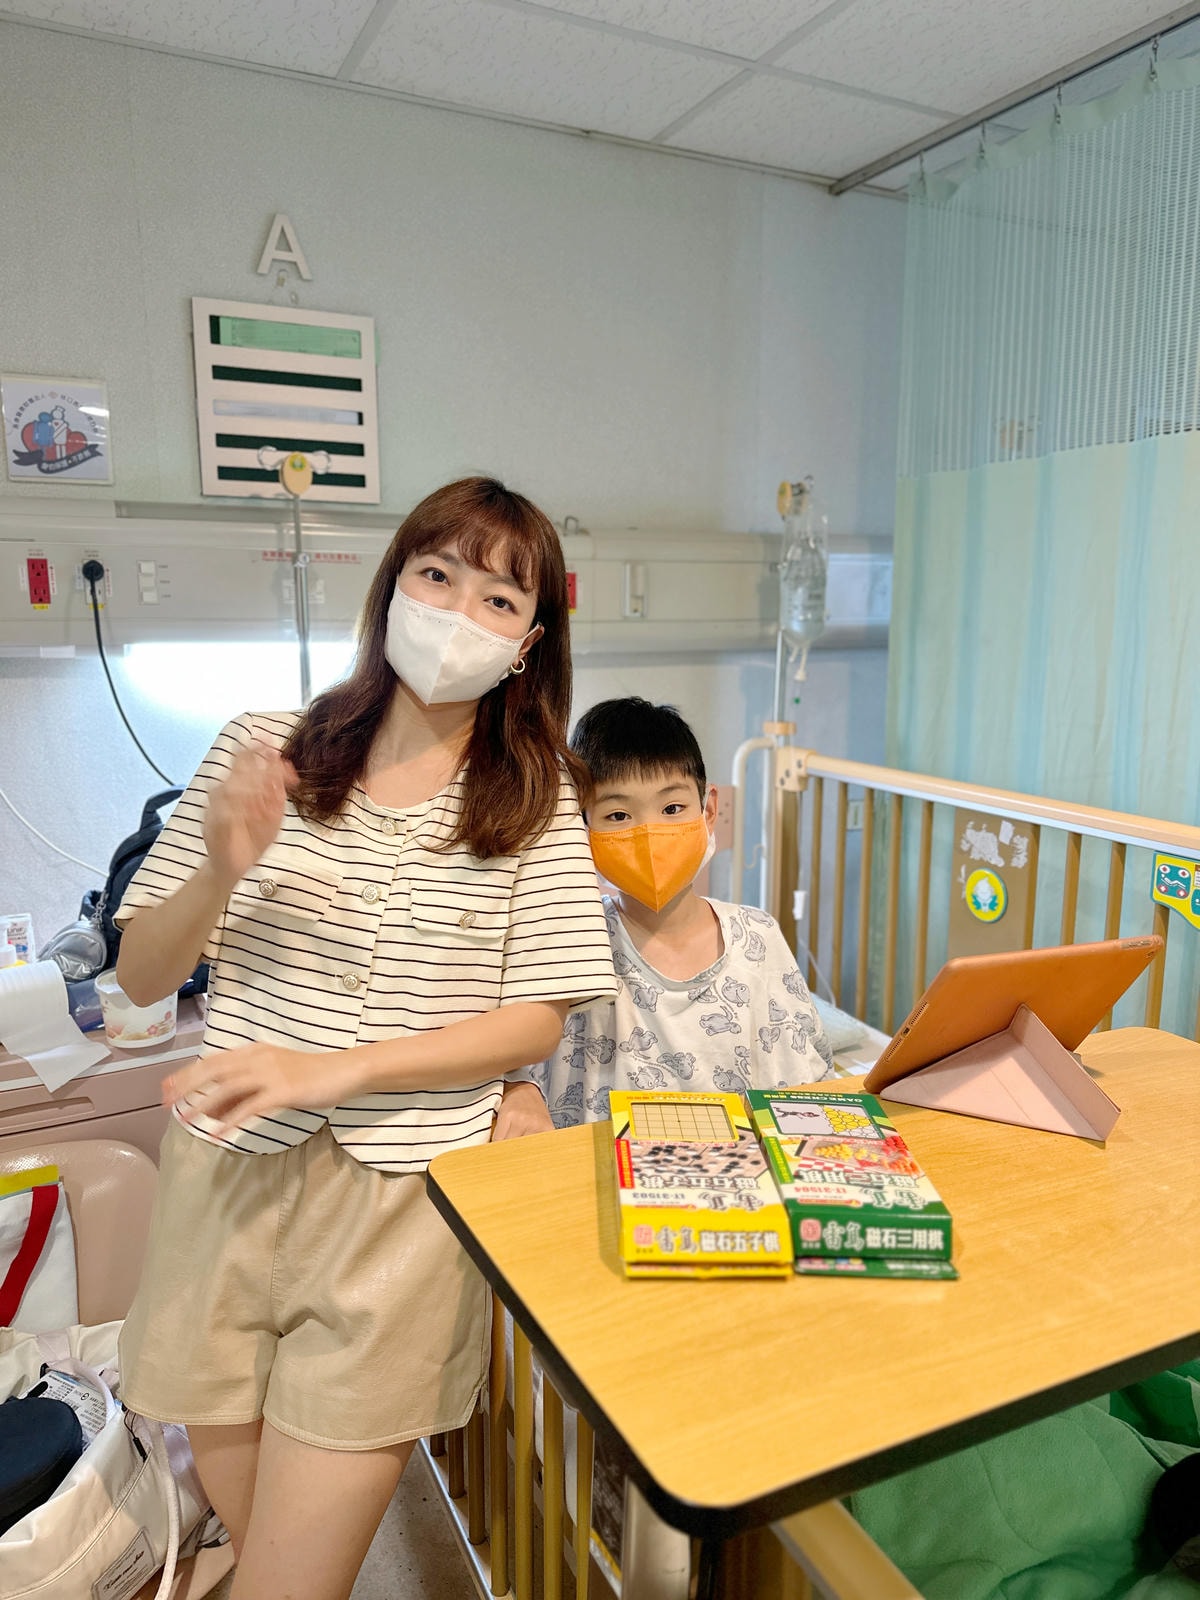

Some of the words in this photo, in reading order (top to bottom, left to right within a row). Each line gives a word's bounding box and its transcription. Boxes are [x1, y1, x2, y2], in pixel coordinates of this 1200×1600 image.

[257, 213, 312, 282] A
[640, 1175, 760, 1190] 磁石五子棋
[700, 1231, 781, 1253] 磁石五子棋
[866, 1227, 944, 1250] 磁石三用棋
